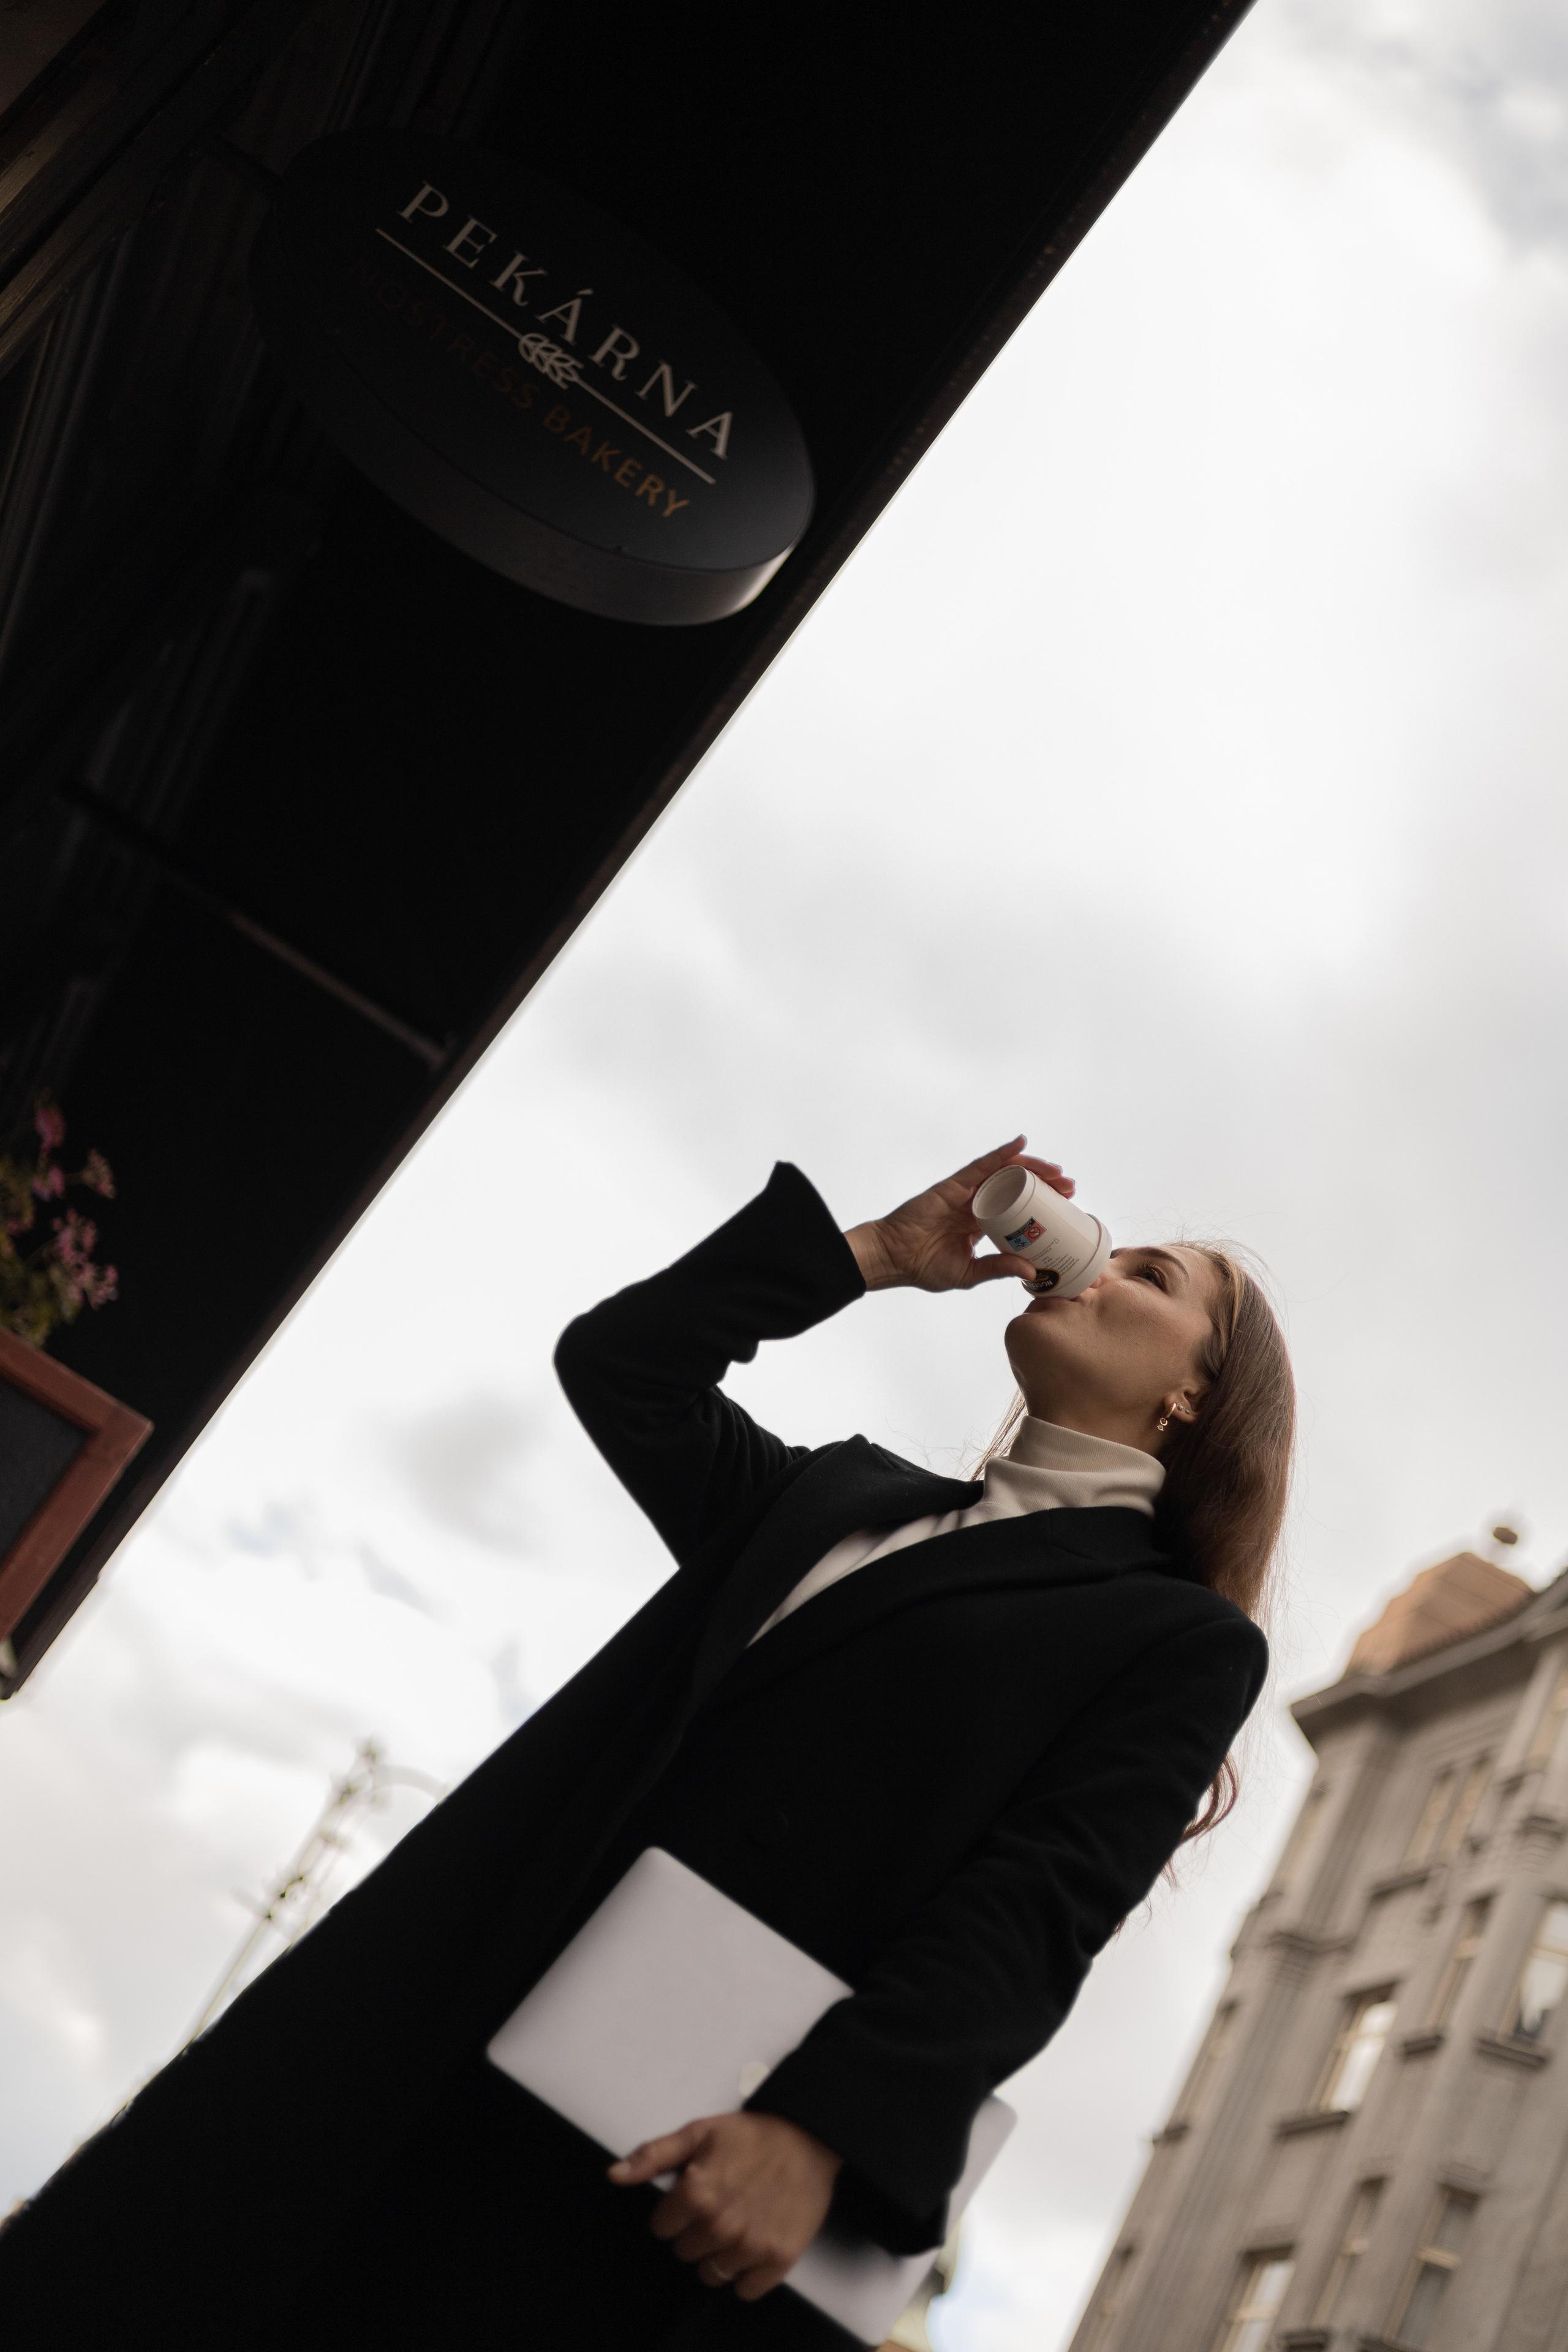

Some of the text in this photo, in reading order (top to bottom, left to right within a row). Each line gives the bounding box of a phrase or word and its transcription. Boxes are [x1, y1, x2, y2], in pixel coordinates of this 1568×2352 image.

[345, 259, 690, 518] NOSTRESS BAKERY
[396, 180, 734, 459] PEKÁRNA
